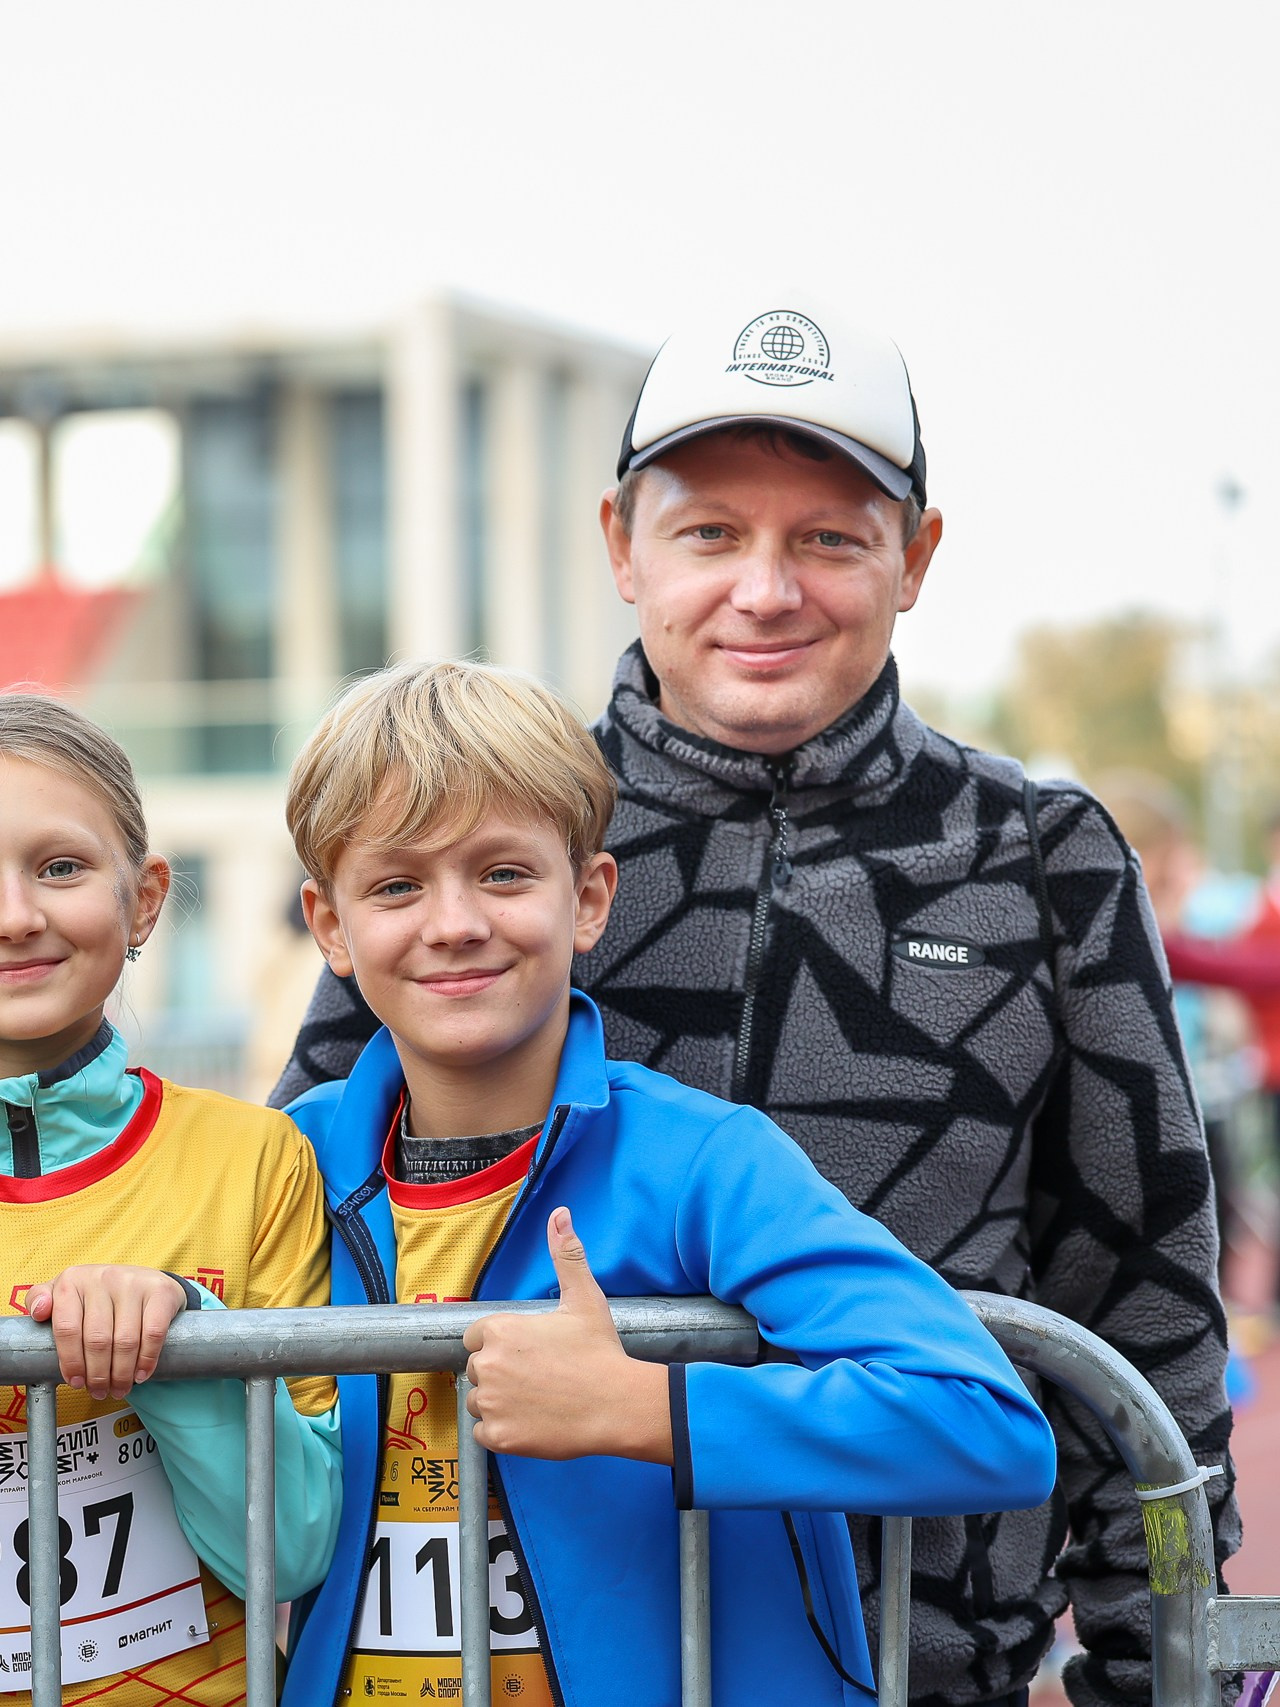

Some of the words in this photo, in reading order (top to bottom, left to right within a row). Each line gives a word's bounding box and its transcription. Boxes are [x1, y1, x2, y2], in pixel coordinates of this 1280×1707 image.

[725, 363, 835, 382] INTERNATIONAL
[908, 941, 969, 963] RANGE
[338, 1185, 376, 1216] SCHOOL
[73, 1471, 103, 1484] МАРАФОНЕ
